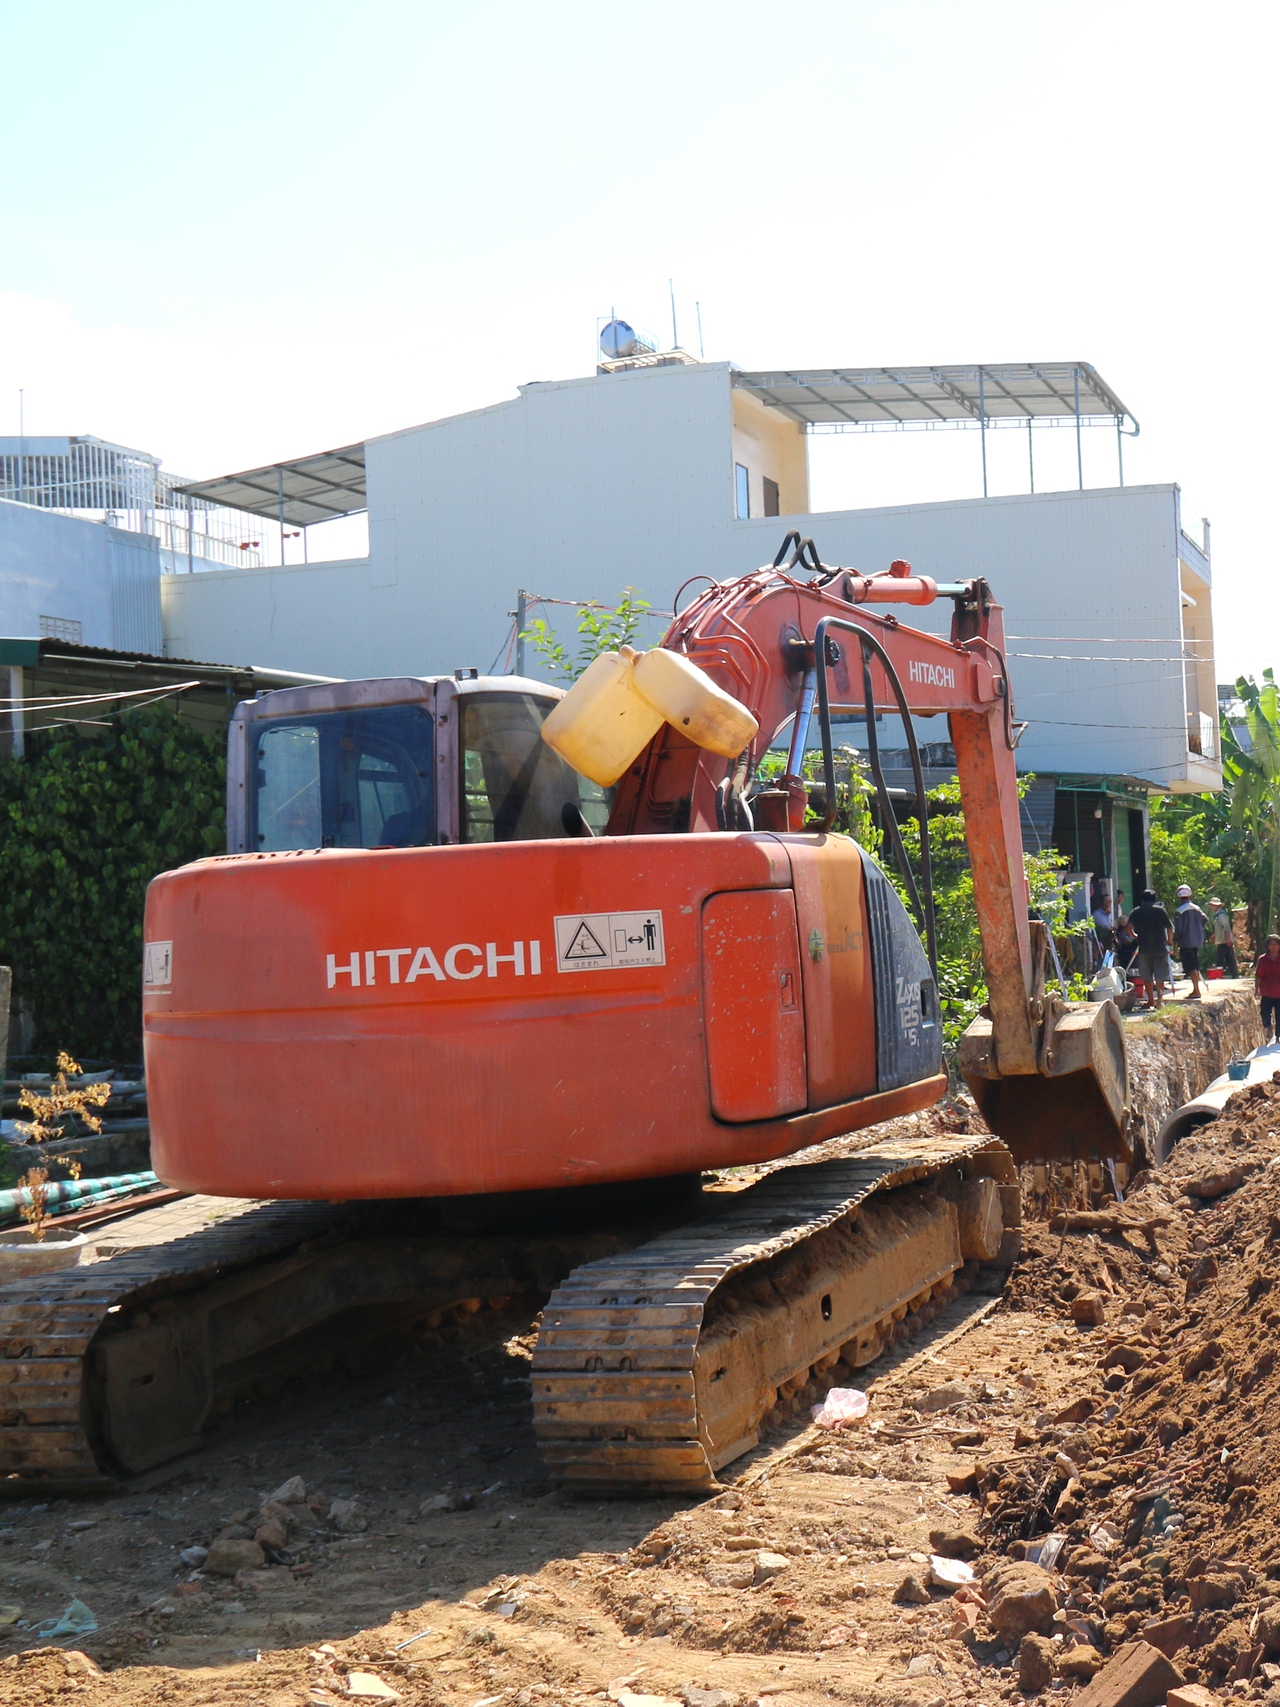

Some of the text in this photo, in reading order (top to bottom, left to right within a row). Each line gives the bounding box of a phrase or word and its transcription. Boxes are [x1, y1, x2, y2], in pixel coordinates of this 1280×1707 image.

[909, 660, 955, 688] HITACHI
[326, 940, 541, 989] HITACHI
[900, 1005, 920, 1029] 125
